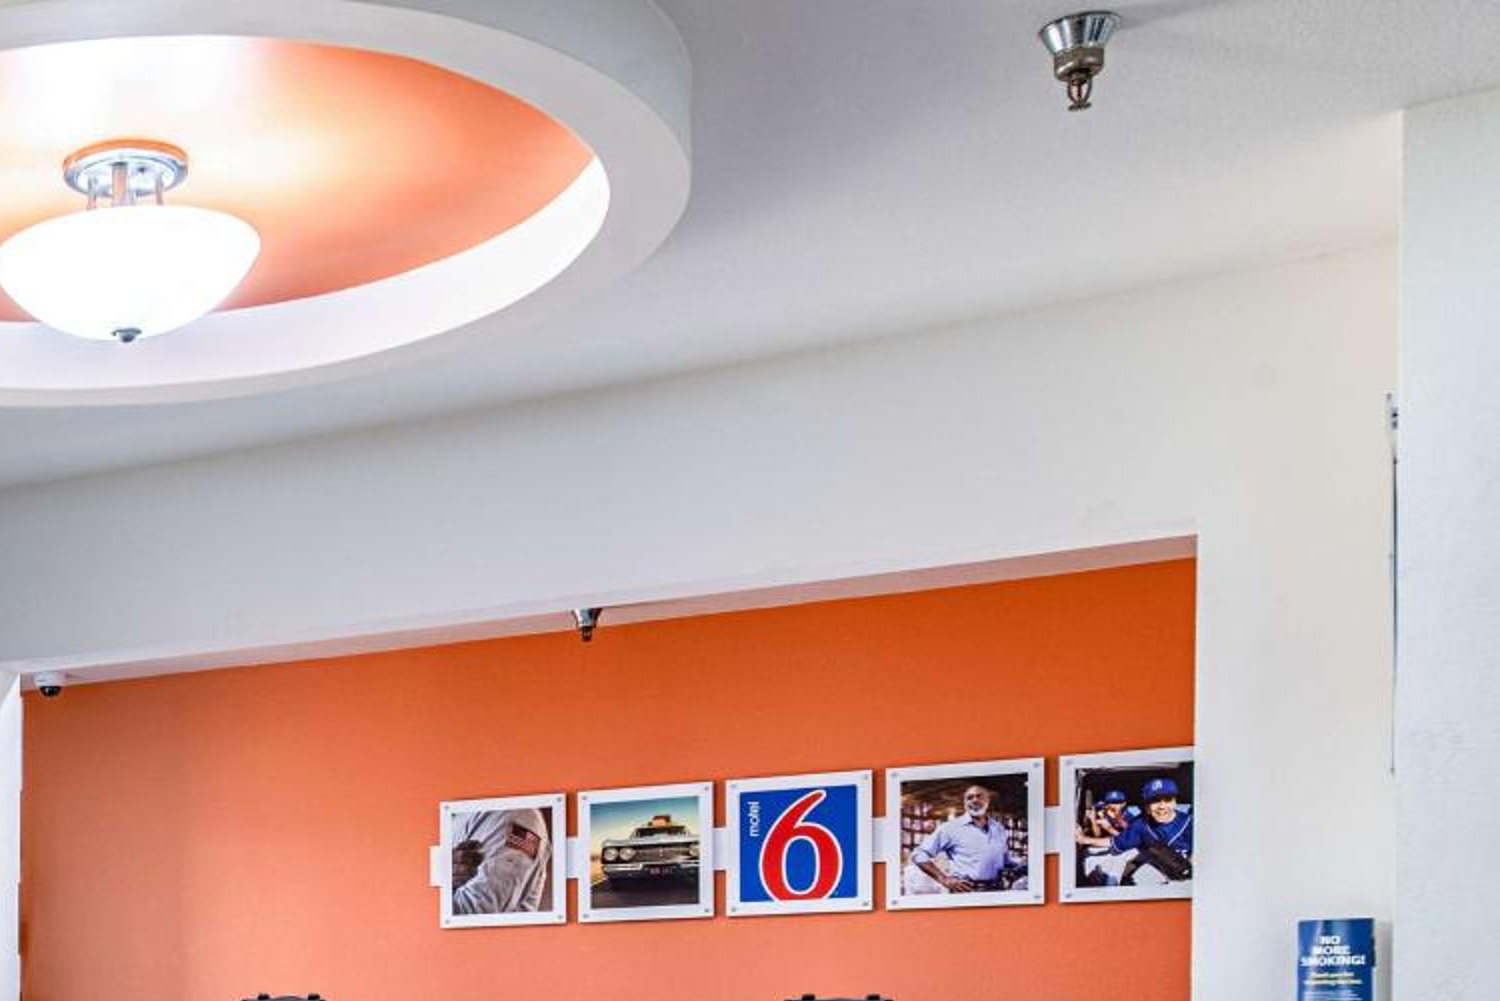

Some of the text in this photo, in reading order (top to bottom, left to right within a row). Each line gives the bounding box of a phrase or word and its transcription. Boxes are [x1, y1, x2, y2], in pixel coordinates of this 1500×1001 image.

[759, 789, 844, 904] 6
[1320, 935, 1341, 945] NO
[1312, 945, 1351, 955] MORE
[1300, 954, 1366, 967] SMOKING!
